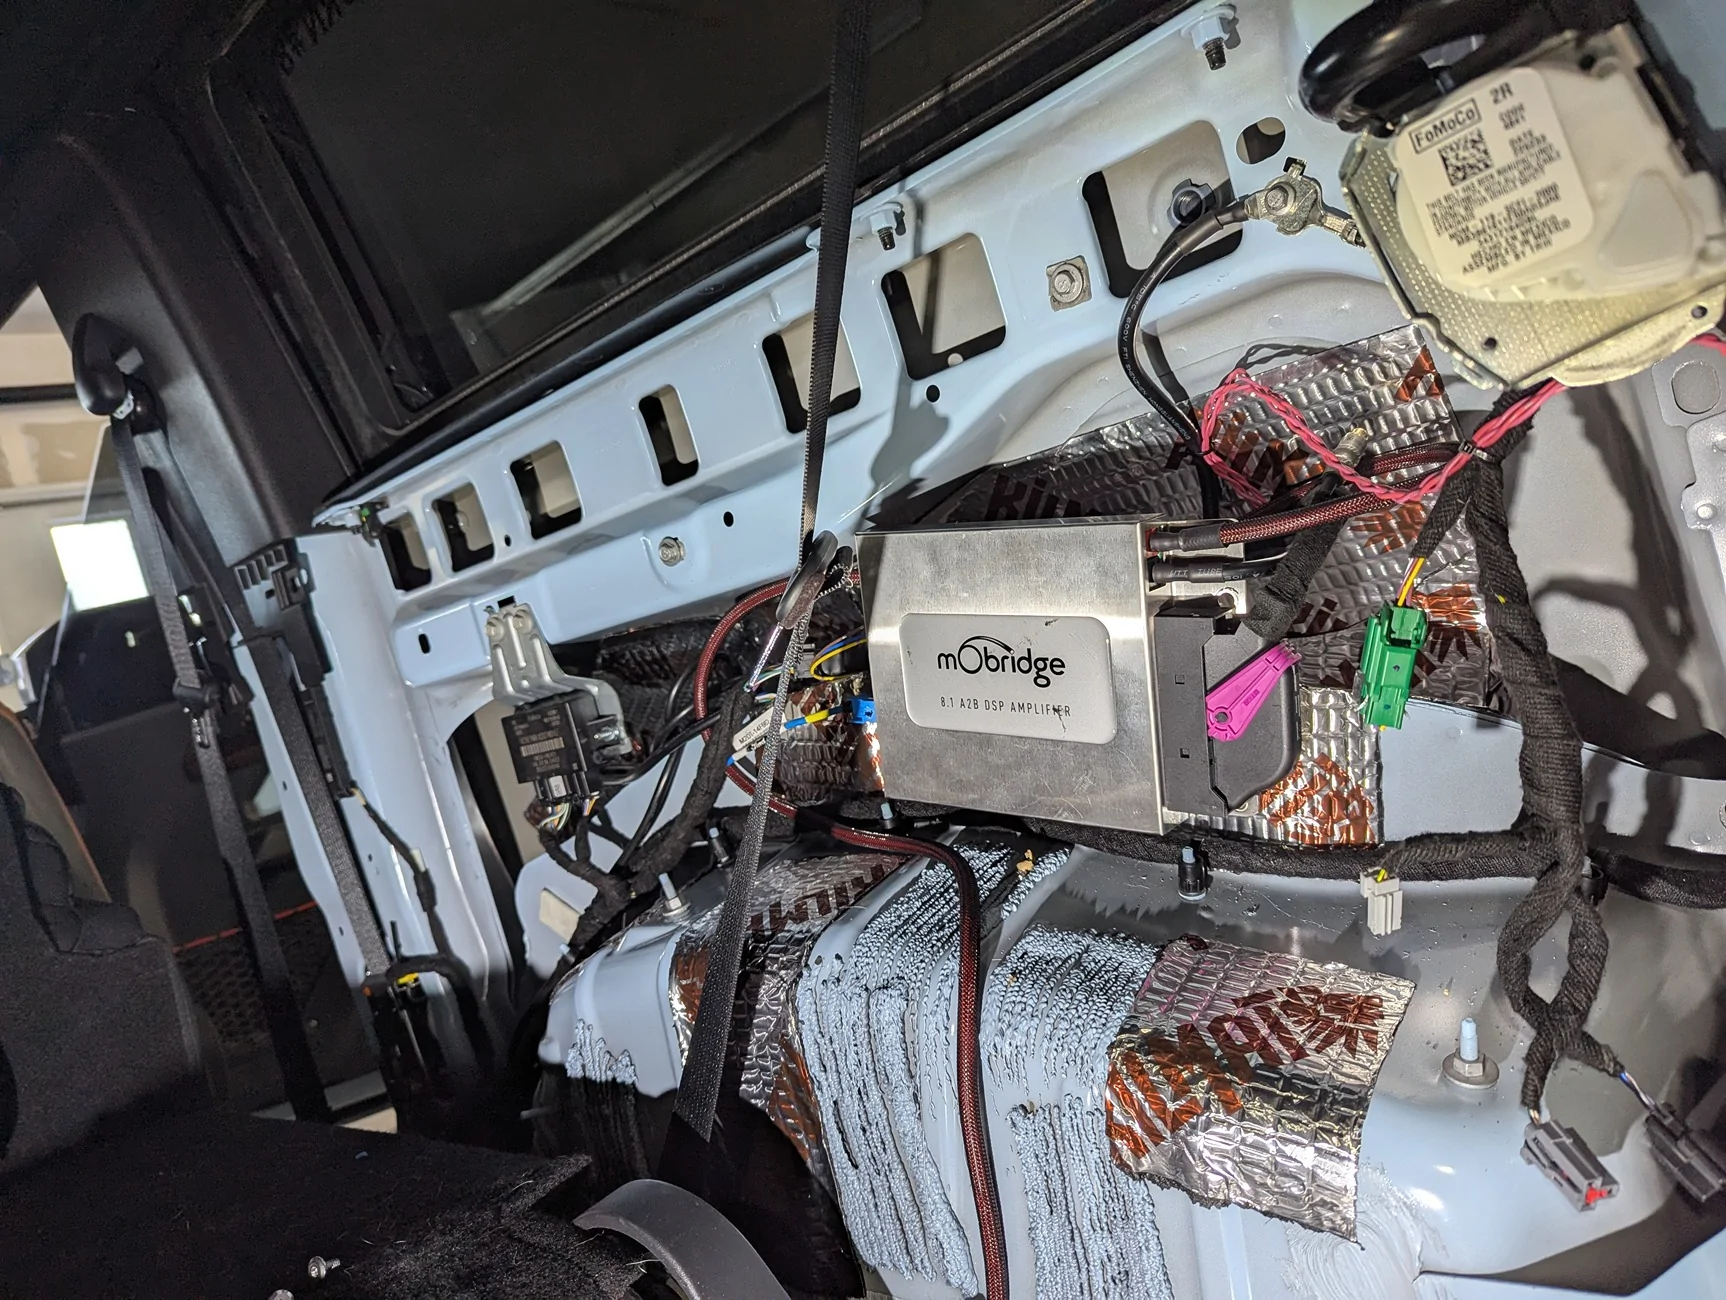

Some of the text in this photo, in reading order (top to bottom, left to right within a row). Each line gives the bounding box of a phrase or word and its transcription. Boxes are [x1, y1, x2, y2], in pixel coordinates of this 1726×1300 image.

[1488, 81, 1514, 104] 2R
[1414, 106, 1476, 148] FoMoCo
[940, 696, 1071, 717] 8.1 A2B DSP AMPLIFIER
